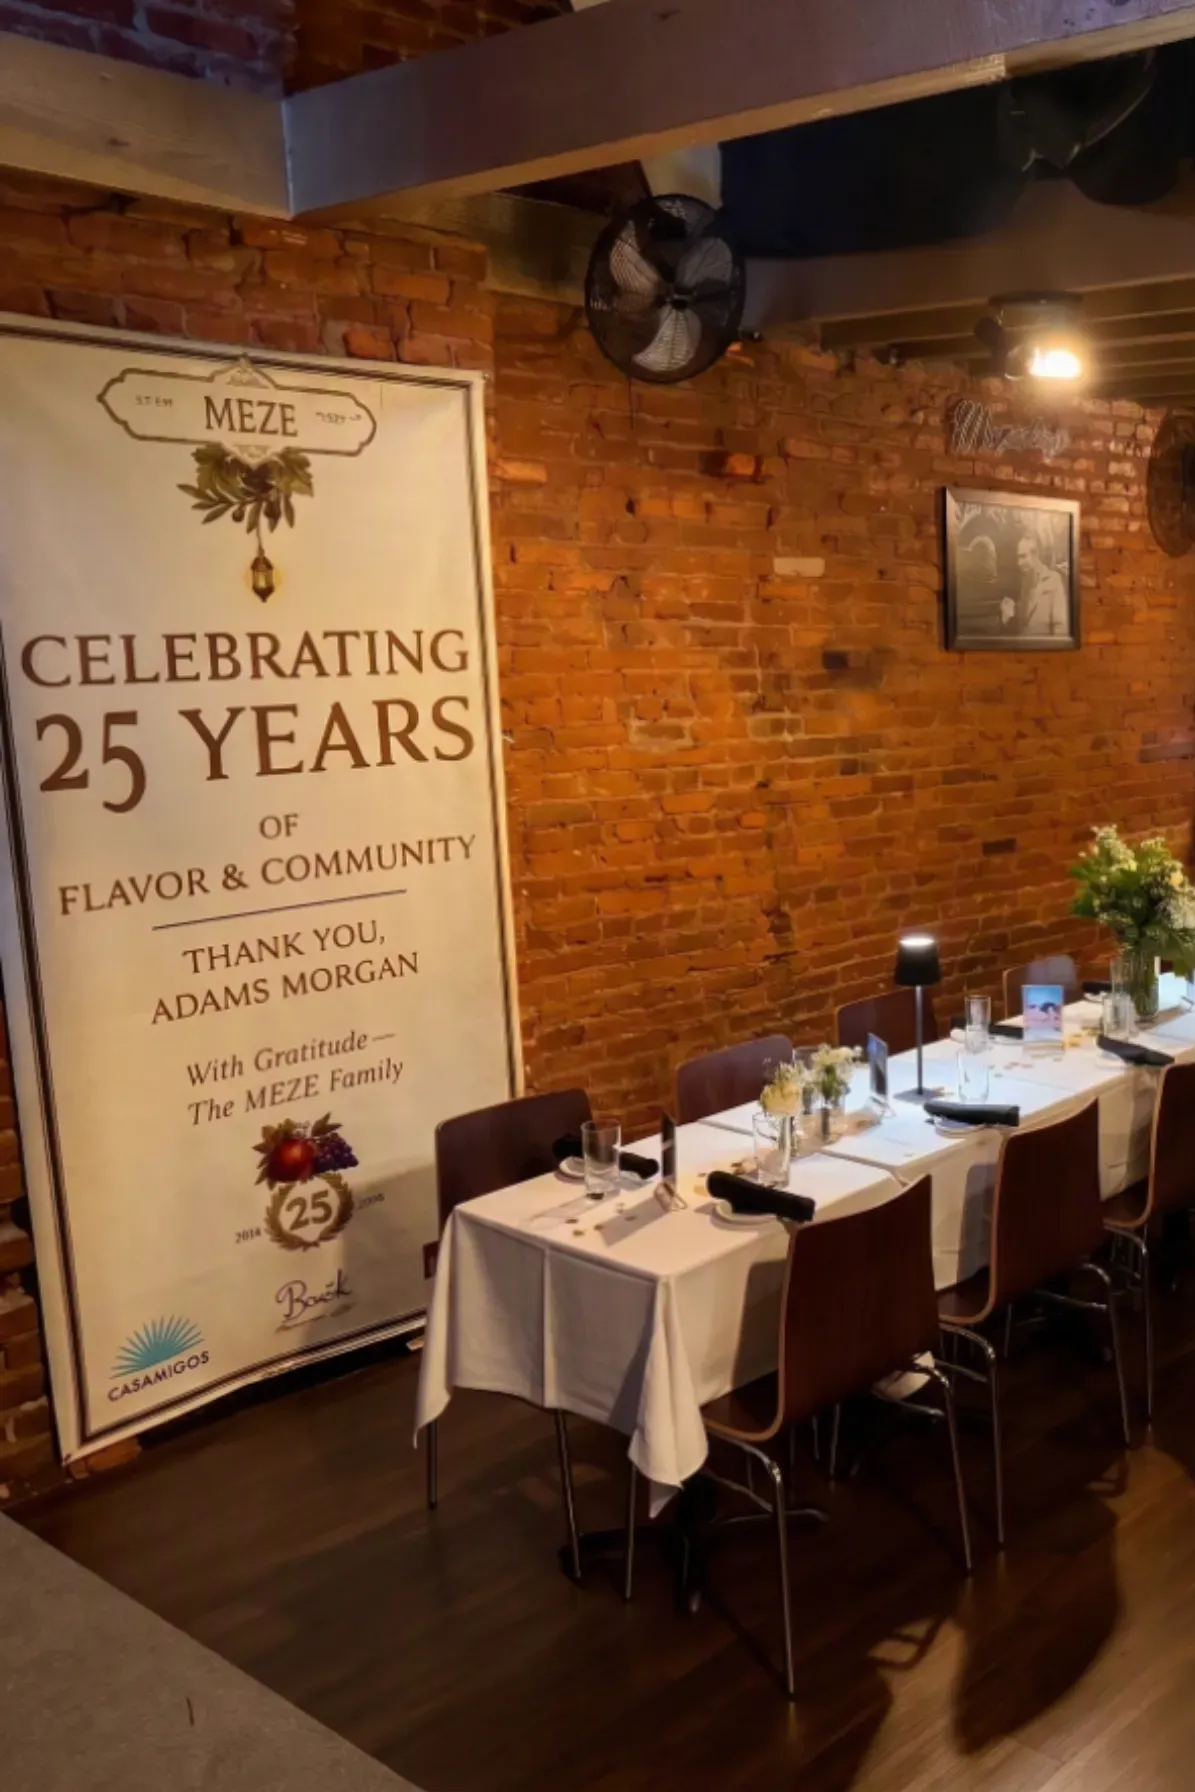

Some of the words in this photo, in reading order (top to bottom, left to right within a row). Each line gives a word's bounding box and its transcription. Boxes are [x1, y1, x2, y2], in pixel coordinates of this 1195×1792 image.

[203, 396, 298, 437] MEZE
[20, 629, 470, 688] CELEBRATING
[35, 711, 146, 813] 25
[179, 697, 475, 781] YEARS
[259, 813, 300, 840] OF
[58, 867, 211, 915] FLAVOR
[221, 862, 249, 890] &
[260, 834, 476, 886] COMMUNITY
[182, 931, 304, 975] THANK
[311, 919, 385, 951] YOU,
[151, 980, 271, 1025] ADAMS
[281, 952, 419, 998] MORGAN
[186, 1056, 245, 1087] With
[187, 1097, 236, 1126] The
[243, 1074, 320, 1113] MEZE
[328, 1057, 404, 1096] Family
[285, 1189, 333, 1231] 25
[107, 1350, 211, 1401] CASAMIGOS
